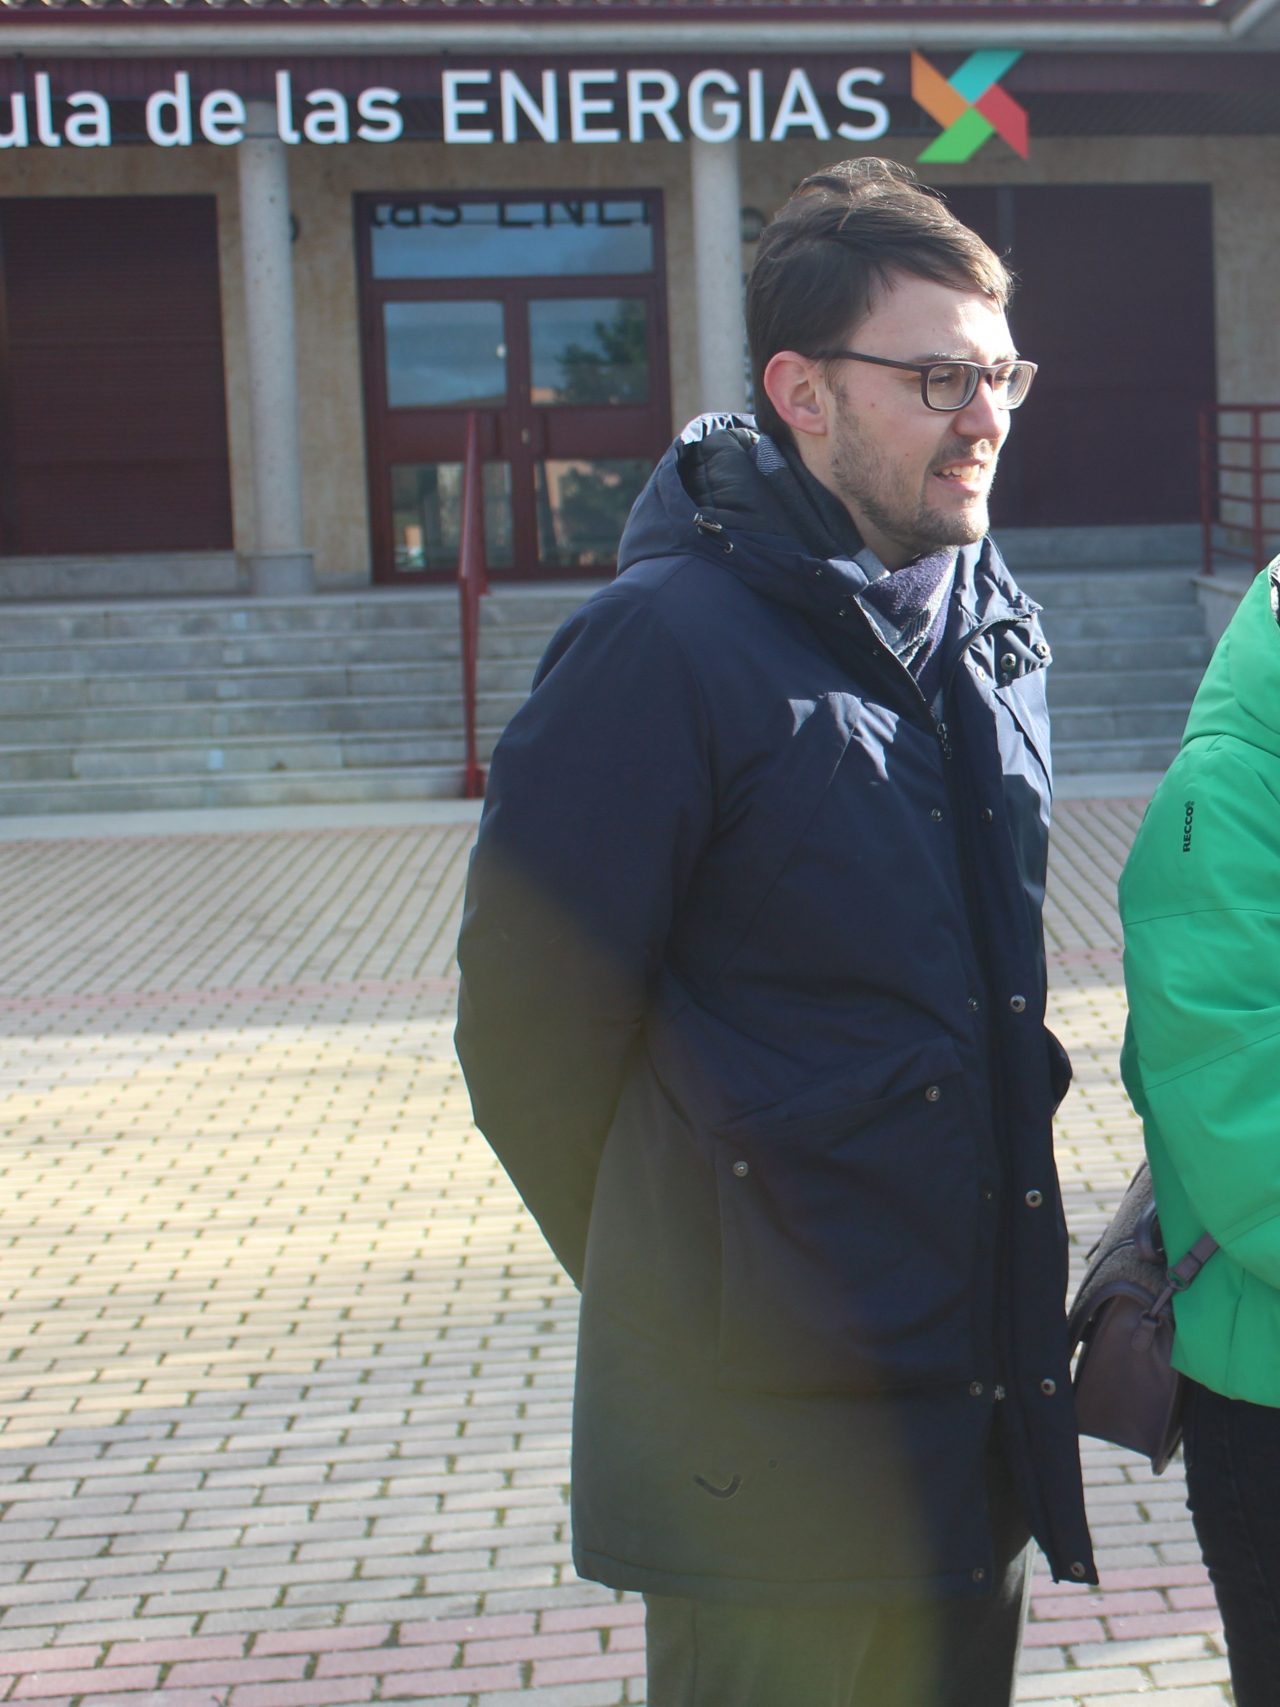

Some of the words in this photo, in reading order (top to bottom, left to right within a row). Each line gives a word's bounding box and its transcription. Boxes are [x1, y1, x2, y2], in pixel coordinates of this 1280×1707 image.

[146, 70, 246, 147] de
[276, 69, 404, 145] las
[441, 67, 890, 144] ENERGIAS
[1183, 806, 1194, 853] RECCO
